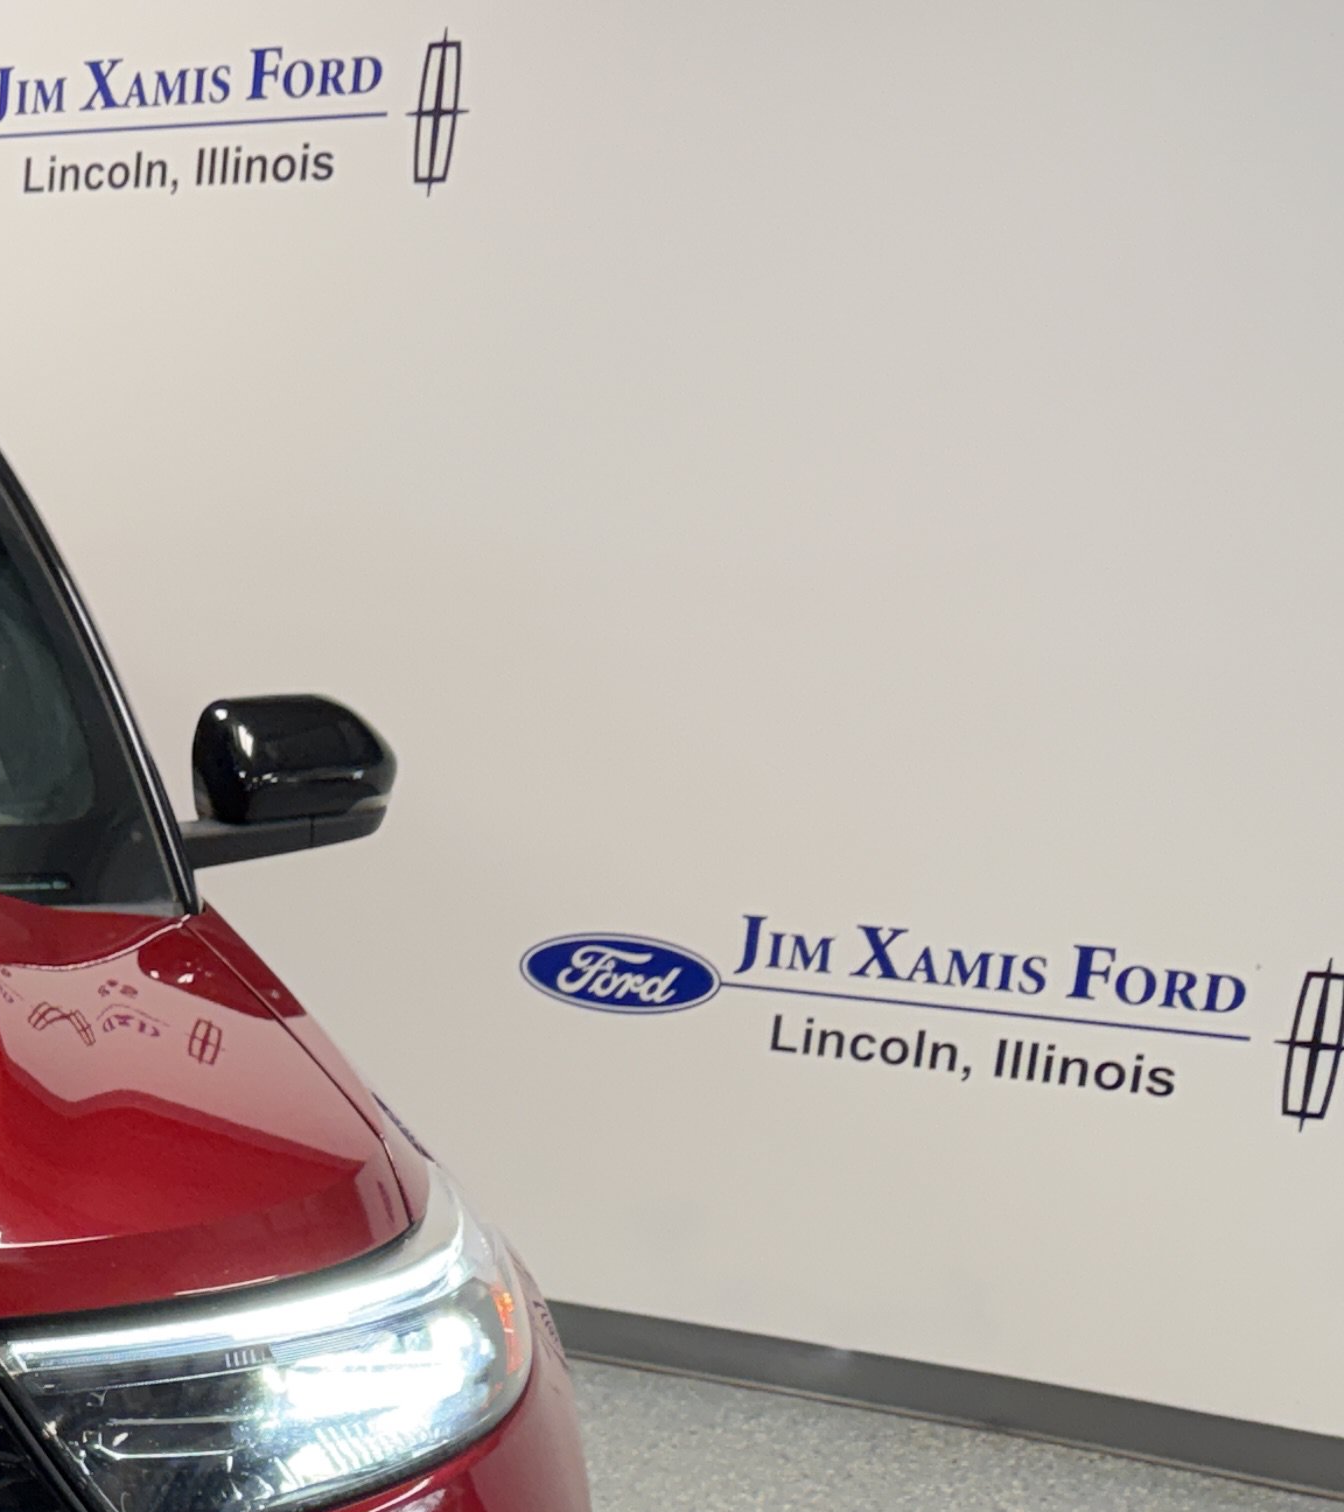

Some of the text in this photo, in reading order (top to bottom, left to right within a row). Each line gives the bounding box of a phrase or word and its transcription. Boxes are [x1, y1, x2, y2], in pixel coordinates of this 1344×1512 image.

[80, 58, 231, 111] XAMIS
[246, 47, 383, 101] FORD
[24, 146, 335, 194] Lincoln, Illinois
[556, 947, 677, 1006] Ford
[734, 913, 1247, 1013] JIM XAMIS FORD
[769, 1014, 1177, 1097] Lincoln, Illinois
